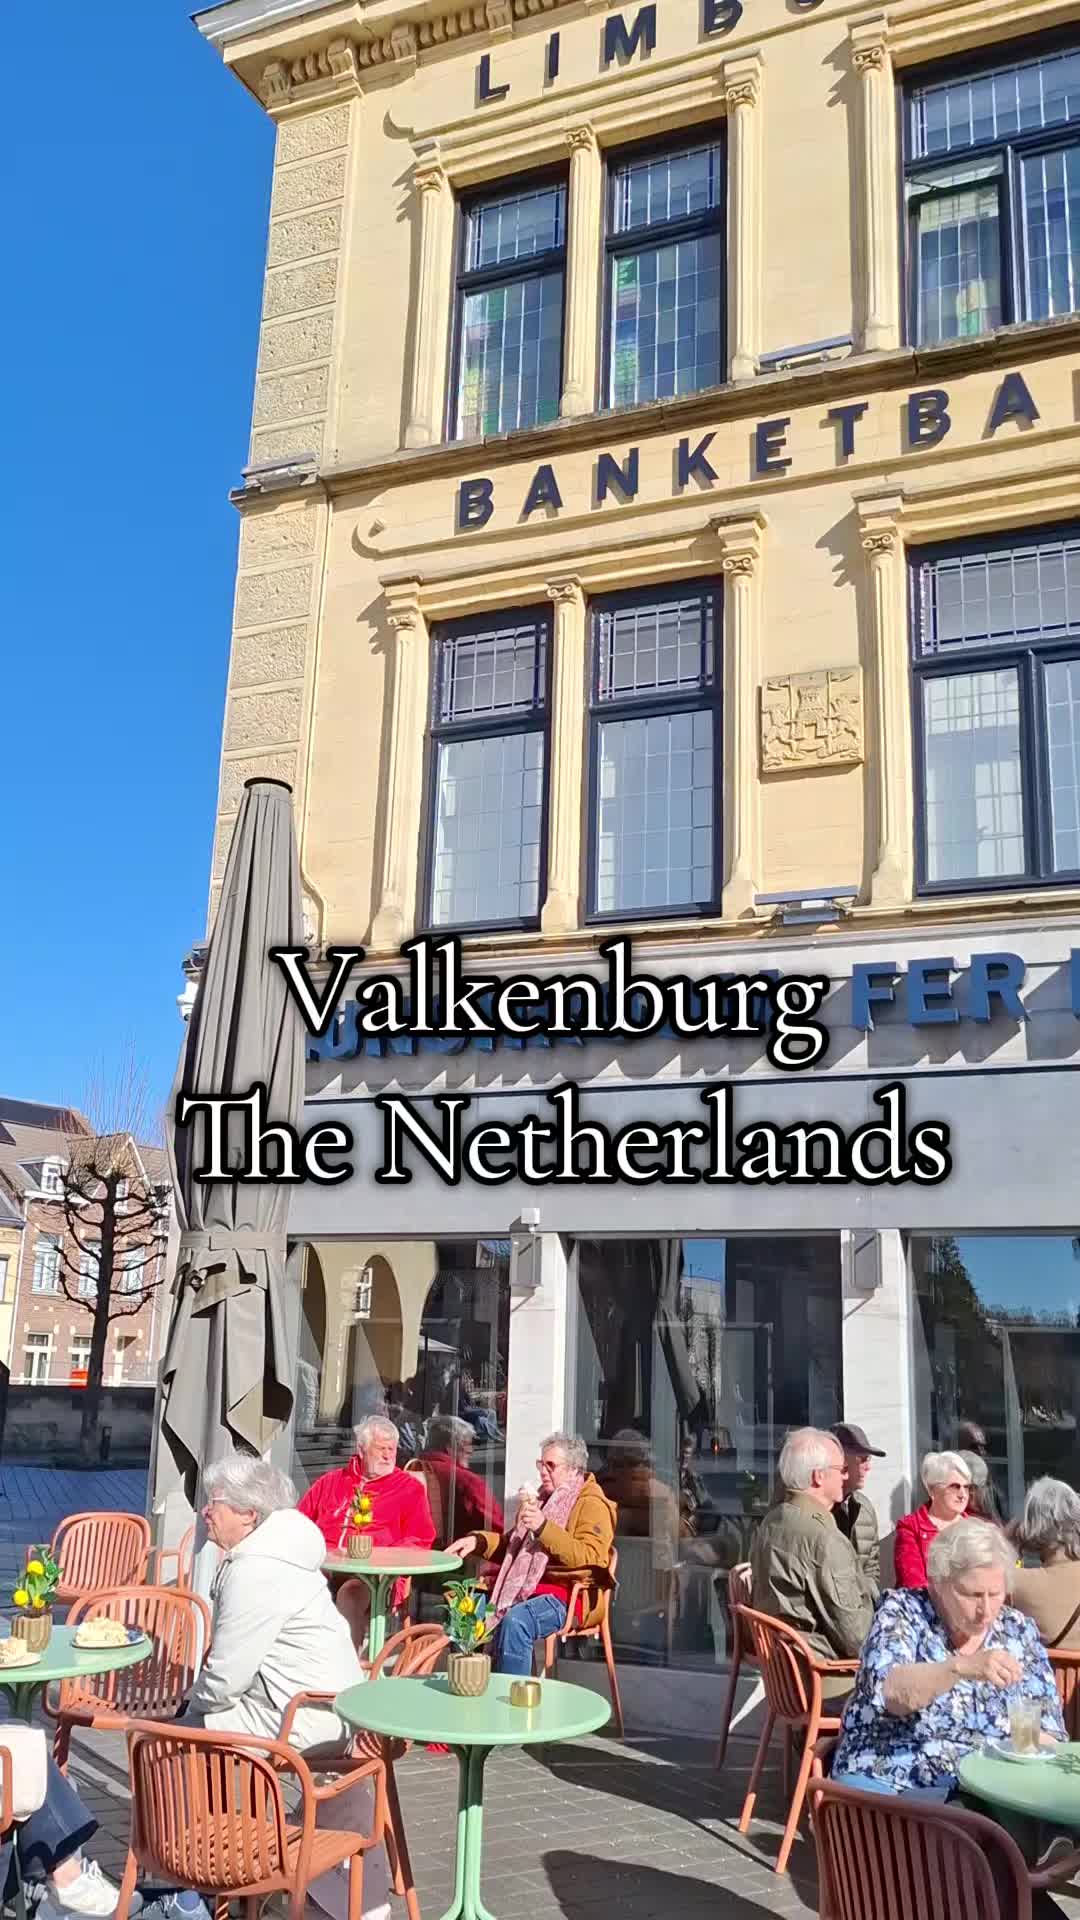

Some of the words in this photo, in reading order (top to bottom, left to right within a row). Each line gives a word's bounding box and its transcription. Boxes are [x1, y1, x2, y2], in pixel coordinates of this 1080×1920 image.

[477, 0, 825, 101] LIMB
[457, 371, 1080, 530] BANKETBA
[852, 947, 1080, 1032] FER
